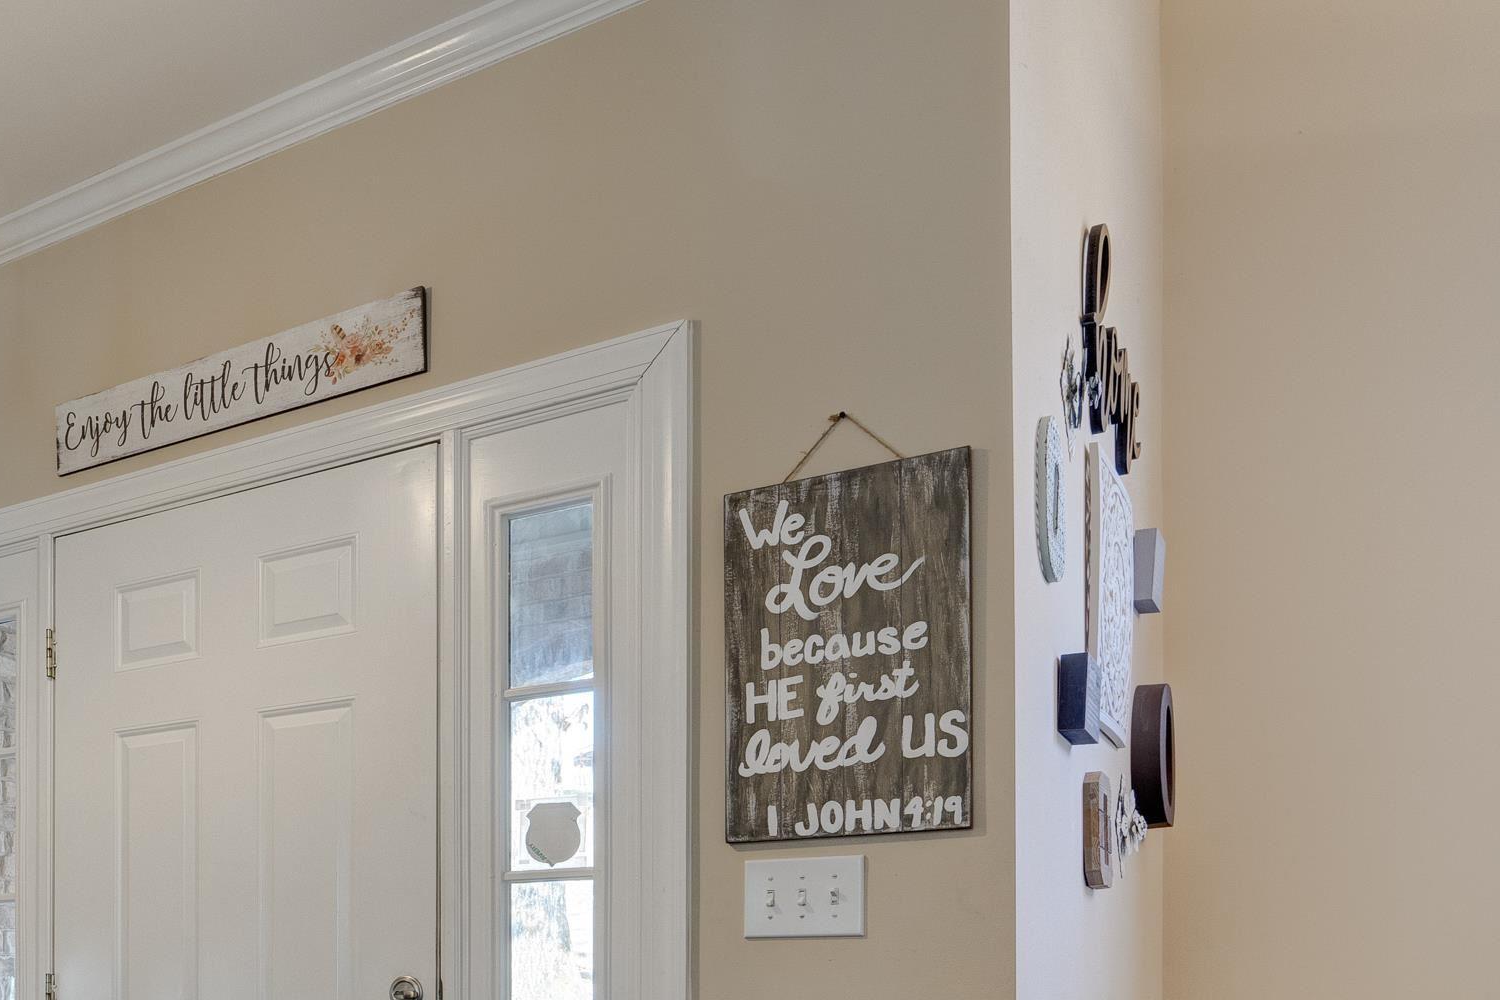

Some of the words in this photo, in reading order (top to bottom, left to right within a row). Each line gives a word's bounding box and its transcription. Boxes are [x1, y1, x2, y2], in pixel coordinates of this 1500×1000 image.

[64, 404, 133, 458] Enjoy
[130, 381, 179, 440] the
[182, 359, 247, 422] little
[241, 342, 340, 405] things
[738, 499, 806, 550] We
[764, 533, 925, 621] Love
[759, 620, 929, 671] because
[745, 674, 805, 724] HE
[816, 660, 920, 726] first
[737, 715, 887, 778] loved
[901, 709, 970, 760] US
[794, 798, 901, 837] JOHN
[903, 795, 963, 829] 4:19
